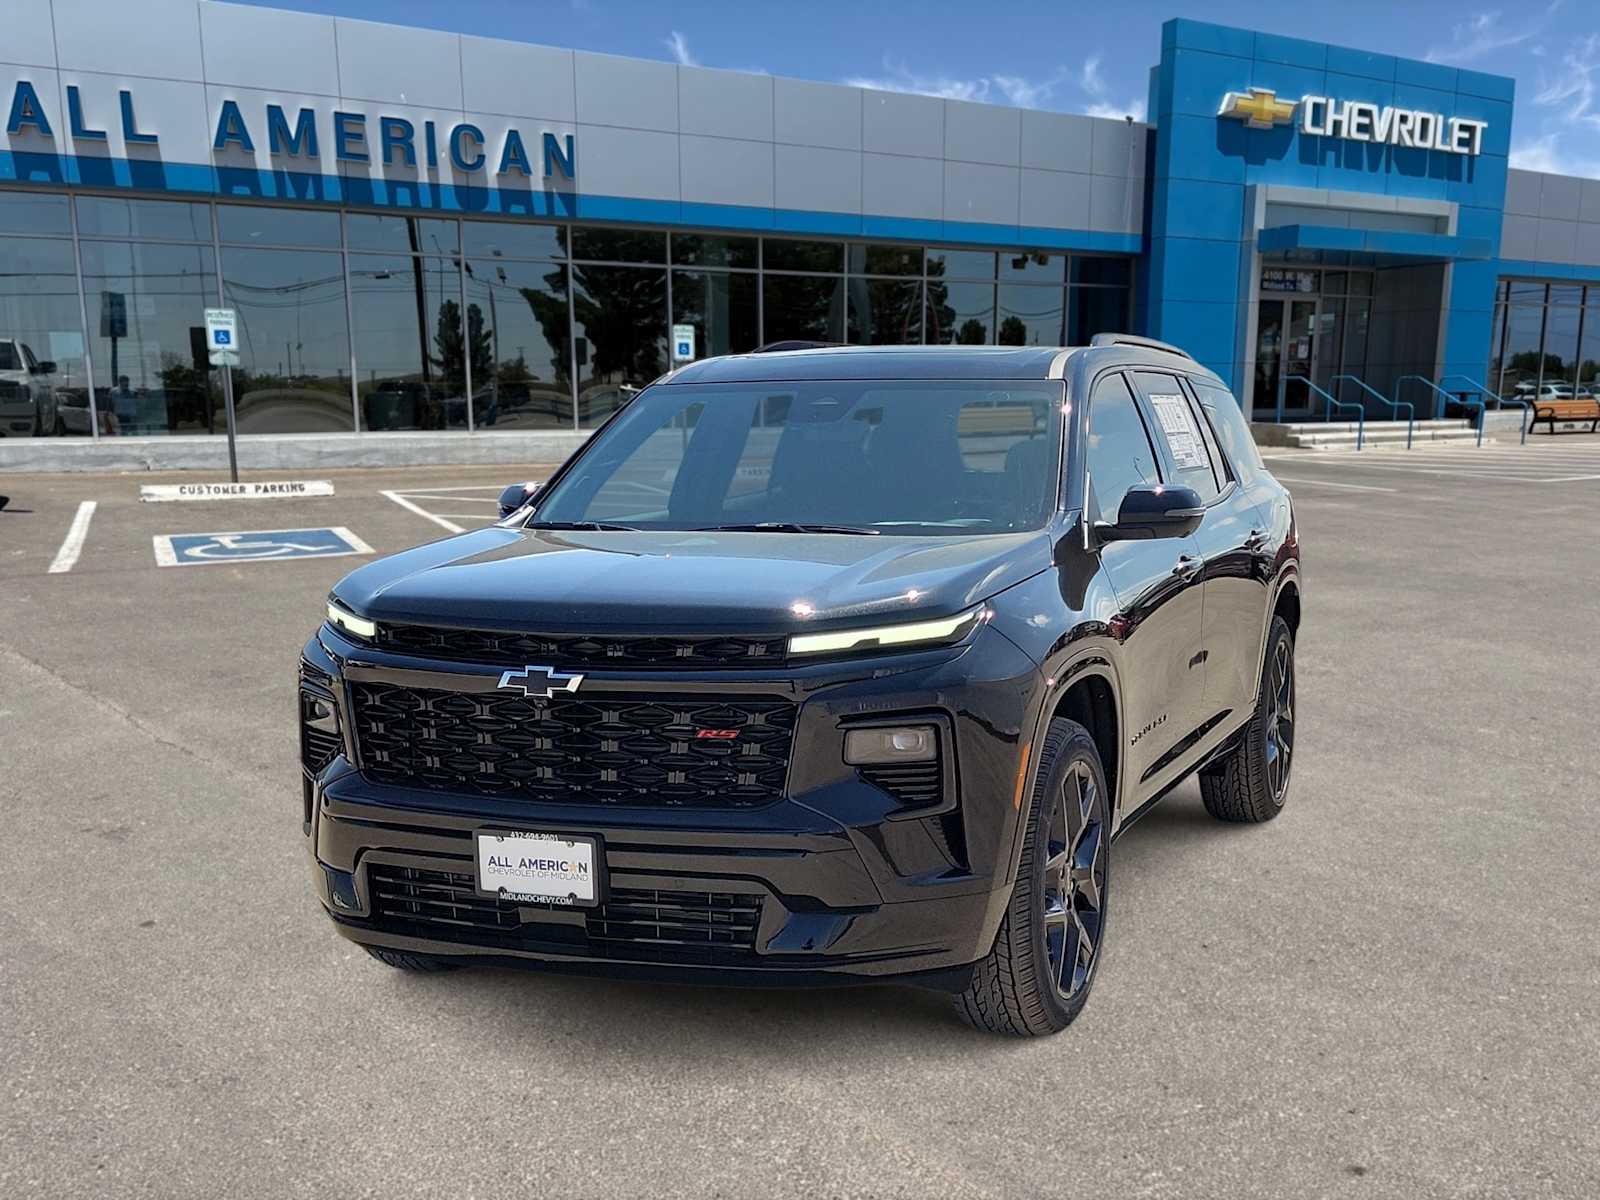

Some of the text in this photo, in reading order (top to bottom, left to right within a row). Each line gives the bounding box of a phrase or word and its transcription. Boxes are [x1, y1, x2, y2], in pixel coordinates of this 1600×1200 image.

[6, 80, 576, 180] ALL AMERICAN
[1302, 94, 1488, 156] CHEVROLET
[179, 482, 306, 495] CUSTOMER PARKING
[696, 729, 737, 739] RS
[488, 855, 513, 868] ALL
[487, 866, 589, 882] CHEVROLET OF MIDLAND
[500, 891, 573, 905] MIDLANDCHEVY.COM
